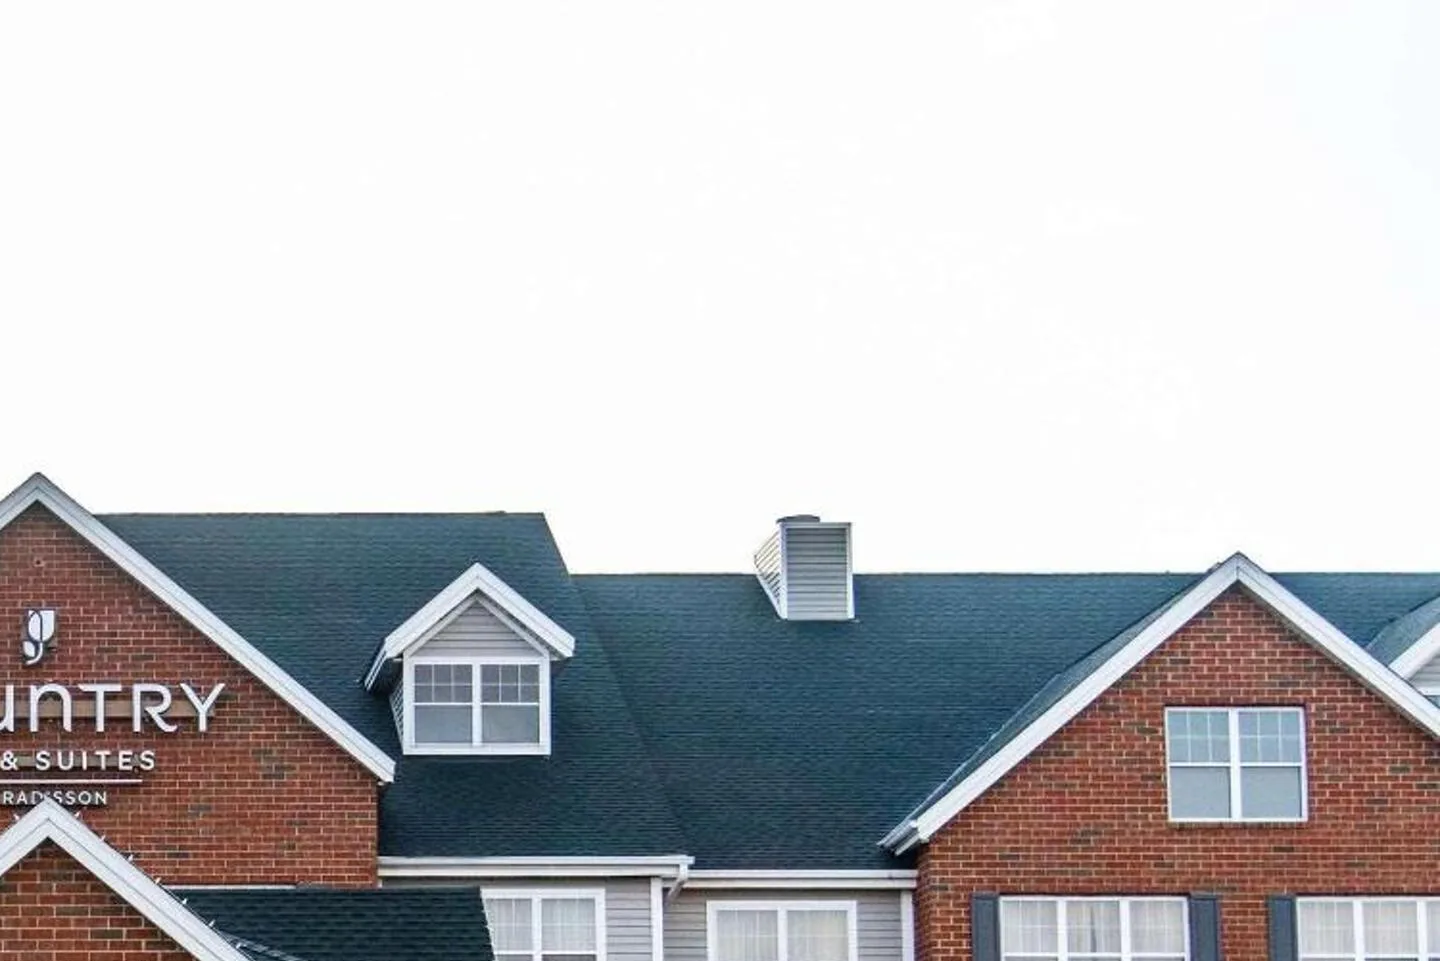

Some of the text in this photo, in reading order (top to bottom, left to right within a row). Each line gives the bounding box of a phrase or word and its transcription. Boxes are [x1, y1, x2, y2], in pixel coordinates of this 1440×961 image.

[0, 750, 20, 772] &
[35, 749, 157, 772] SUITES
[3, 790, 108, 805] RADSSON
